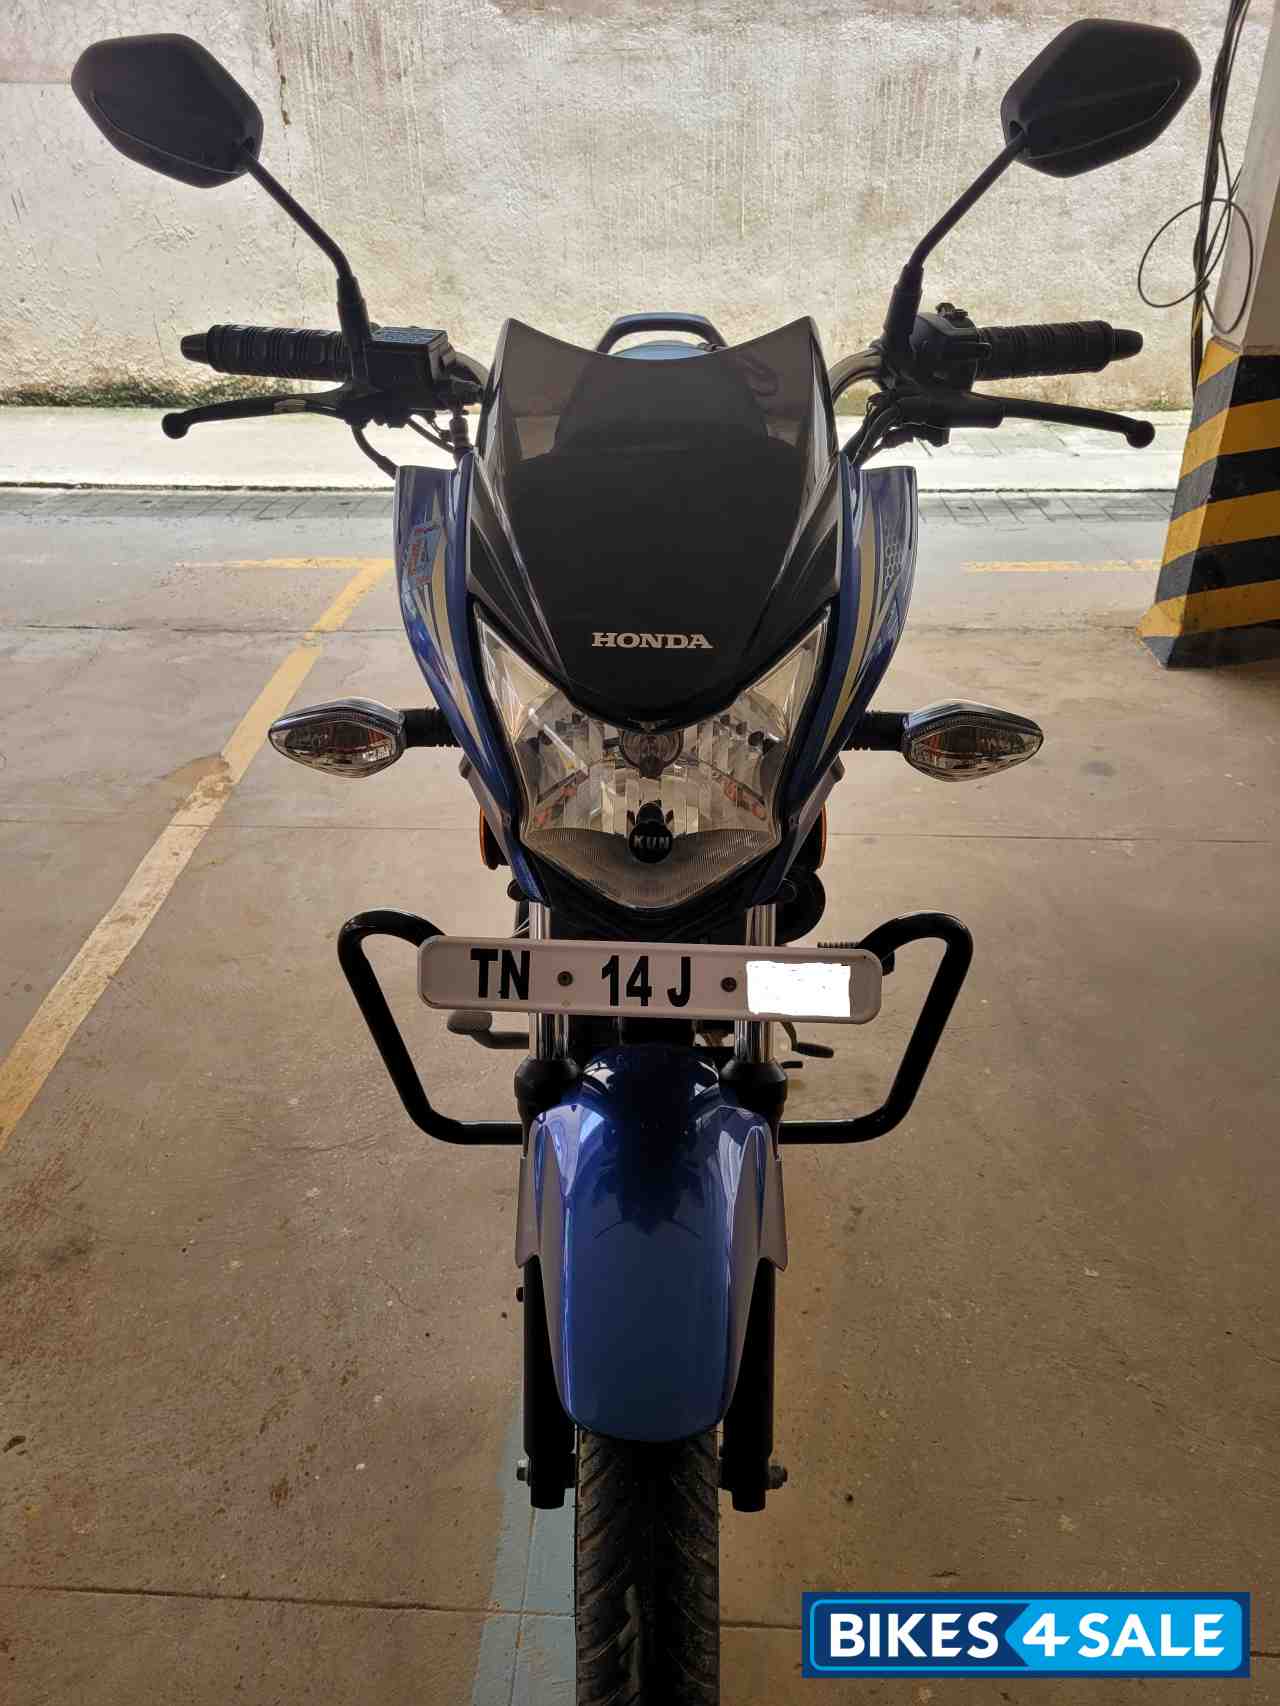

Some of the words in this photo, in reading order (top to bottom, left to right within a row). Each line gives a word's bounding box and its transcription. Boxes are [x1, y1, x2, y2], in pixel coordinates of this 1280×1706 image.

[592, 632, 713, 648] HONDA
[470, 948, 531, 1000] TN
[601, 955, 652, 1007] 14
[667, 956, 691, 1007] J
